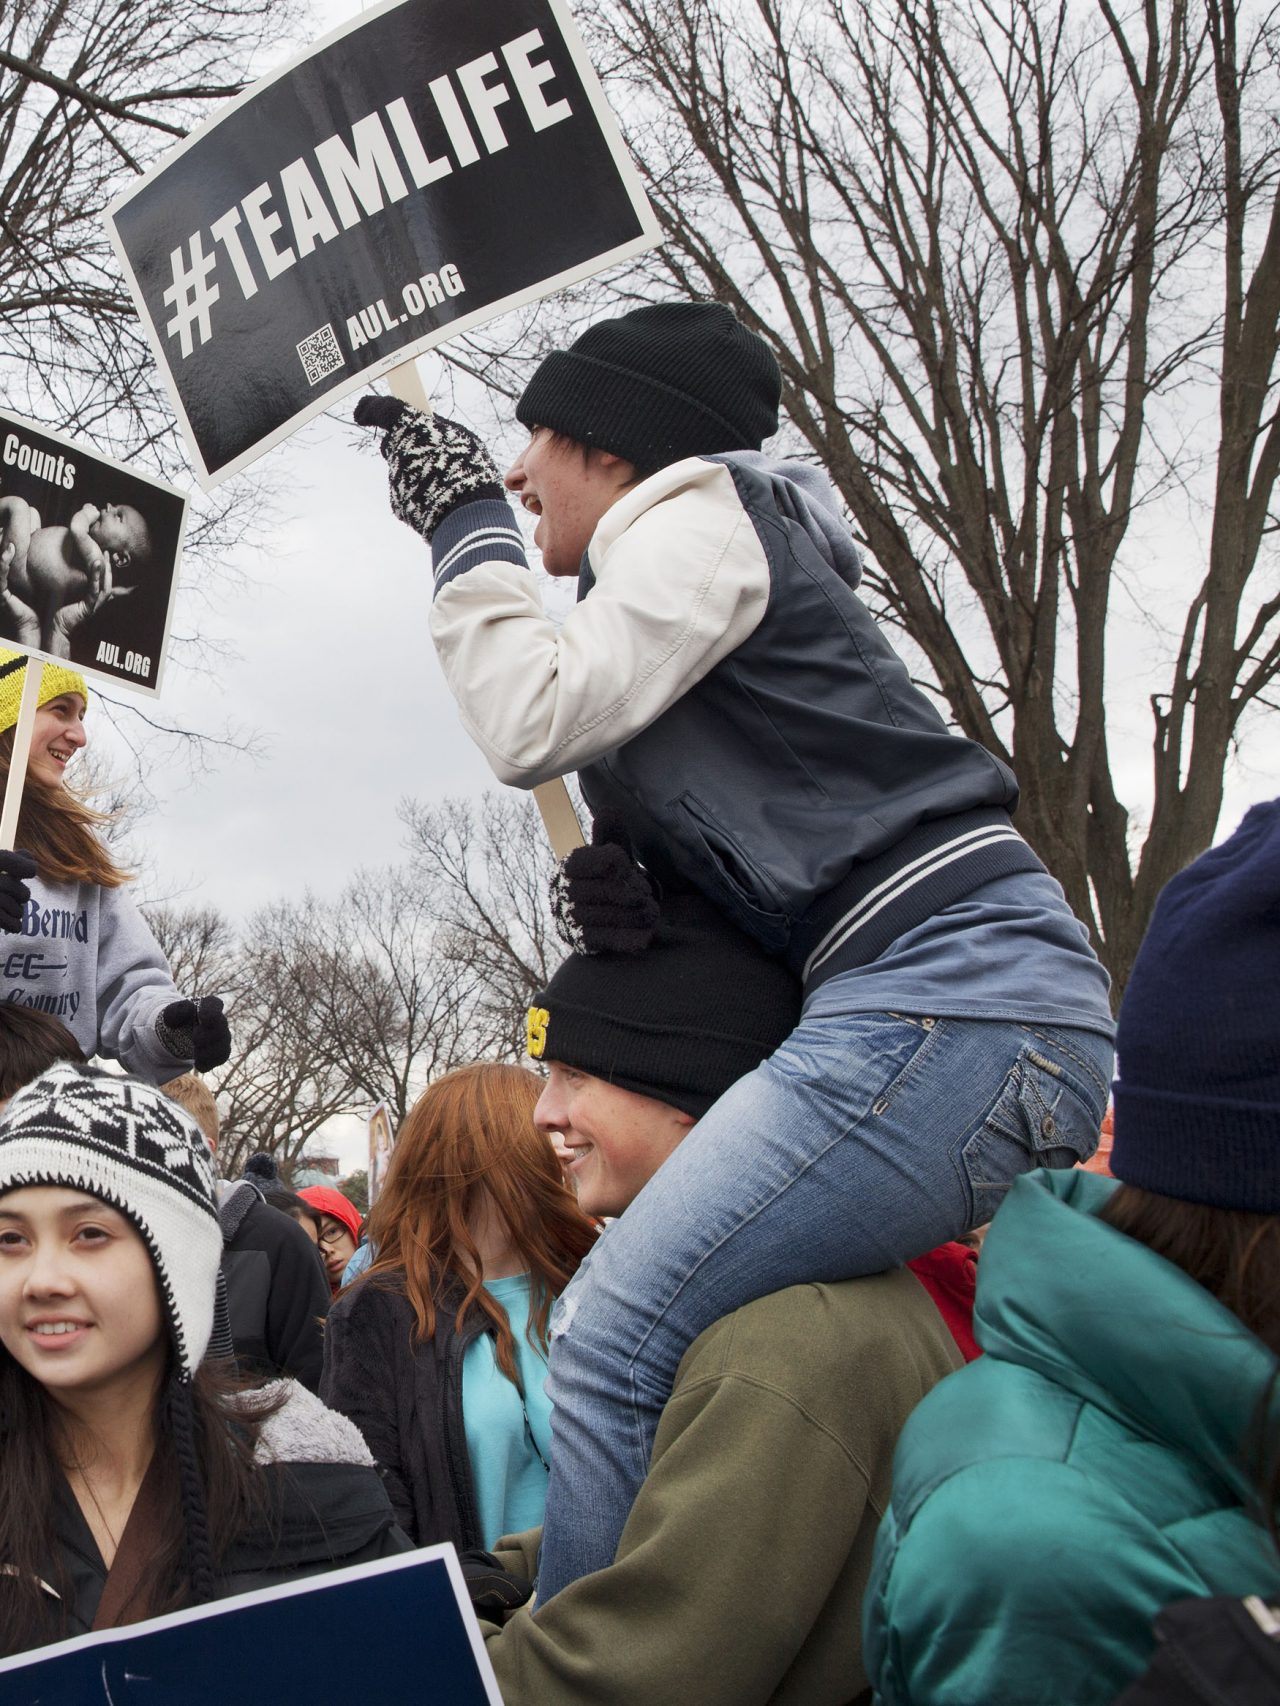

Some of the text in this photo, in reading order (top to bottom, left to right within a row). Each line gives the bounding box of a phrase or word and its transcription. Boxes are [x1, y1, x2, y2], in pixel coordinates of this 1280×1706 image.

[162, 28, 573, 360] #TEAMLIFE
[346, 263, 466, 351] AUL.ORG
[2, 433, 76, 490] Counts
[96, 640, 151, 678] AUL.ORG
